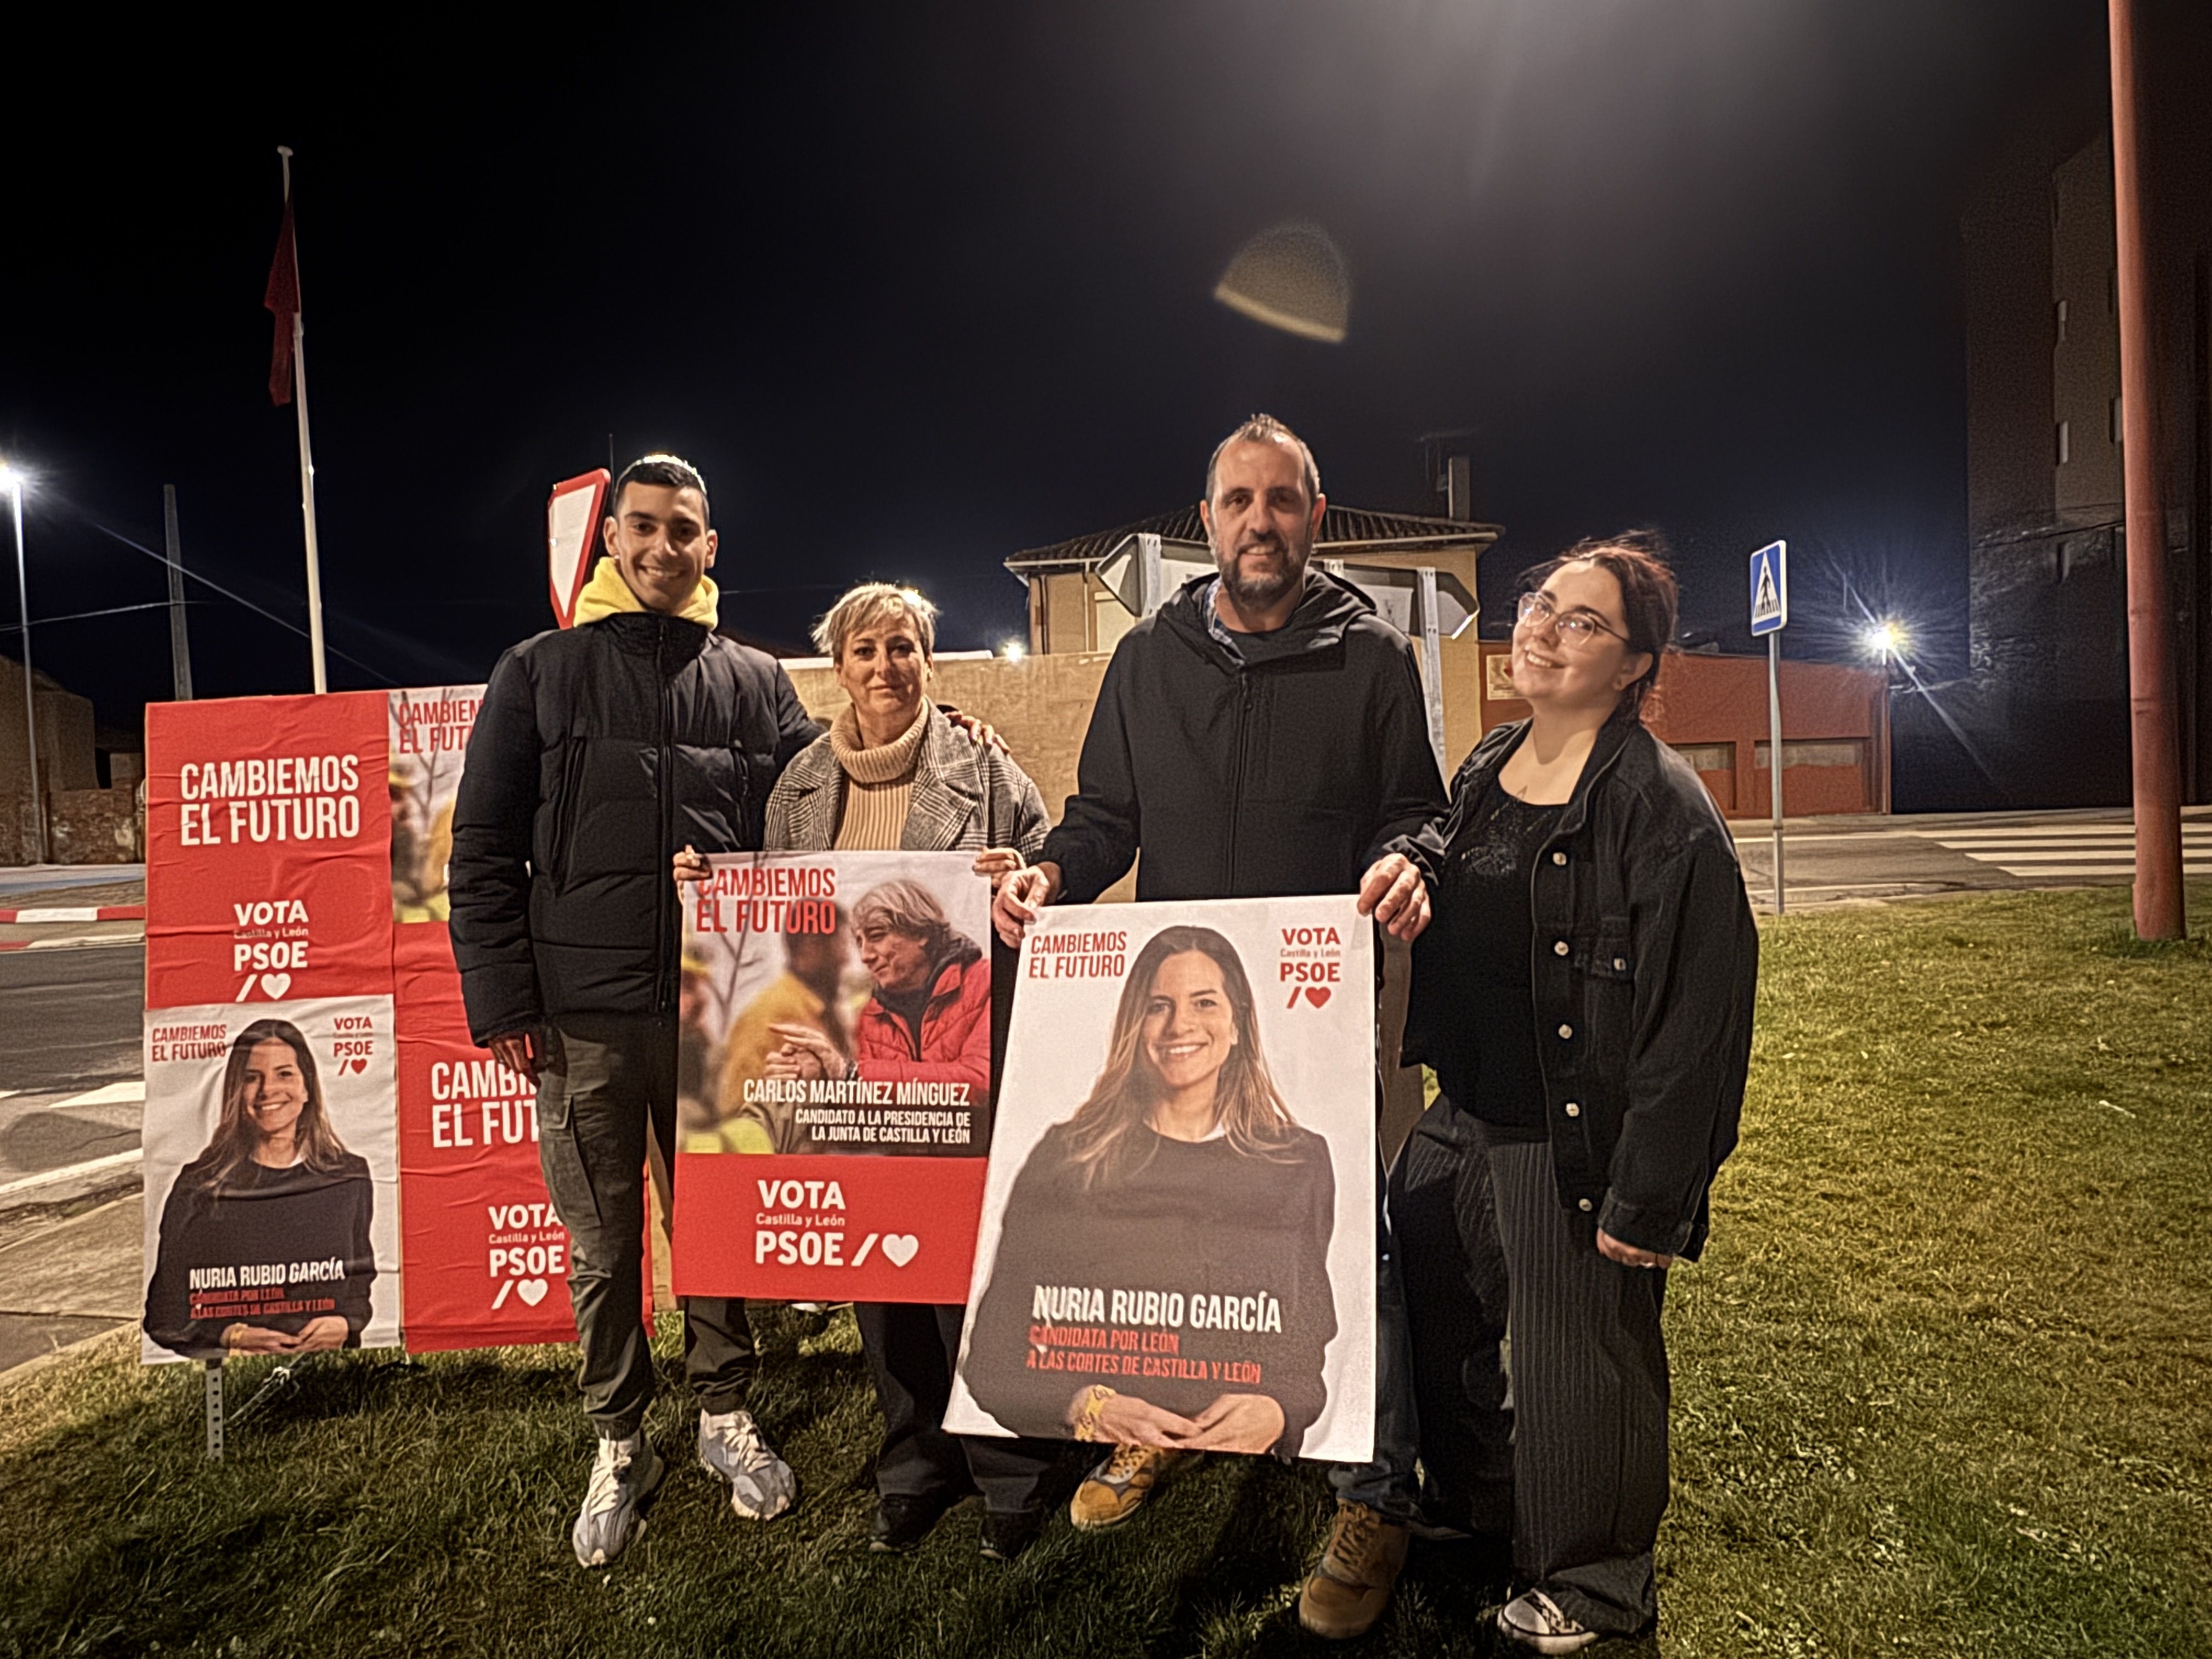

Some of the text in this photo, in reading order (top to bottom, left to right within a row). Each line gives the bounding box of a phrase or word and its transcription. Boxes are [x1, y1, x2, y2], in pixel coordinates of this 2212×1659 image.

[399, 725, 473, 754] EL FUT
[180, 754, 359, 800] CAMBIEMOS
[180, 795, 360, 846] EL FUTURO
[698, 867, 836, 897] CAMBIEMOS
[234, 900, 309, 927] VOTA
[696, 899, 836, 934] EL FUTURO
[1031, 931, 1127, 955] CAMBIEMOS
[1282, 927, 1341, 946] VOTA
[234, 941, 309, 972] PSOE
[1029, 953, 1125, 979] EL FUTURO
[1280, 962, 1341, 983] PSOE
[152, 1024, 227, 1043] CAMBIEMOS
[334, 1017, 373, 1030] VOTA
[152, 1041, 226, 1062] EL FUTURO
[333, 1040, 374, 1058] PSOE
[432, 1060, 538, 1101] CAMBI
[743, 1077, 970, 1107] CARLOS MARTÍNEZ MÍNGUEZ
[432, 1103, 473, 1148] EL
[795, 1108, 971, 1128] CANDIDATO A LA PRESIDENCIA DE
[811, 1125, 970, 1144] LA JUNTA DE CASTILLA Y LEÓN
[757, 1180, 846, 1210] VOTA
[488, 1201, 563, 1231] VOTA
[755, 1212, 845, 1228] Castilla y León
[488, 1228, 565, 1244] Castilla y León
[755, 1230, 844, 1266] PSOE
[190, 1256, 346, 1290] NURIA RUBIO GARCÍA
[489, 1244, 566, 1278] PSOE
[1032, 1284, 1282, 1334] NURIA RUBIO GARCÍA
[1028, 1324, 1107, 1349] CANDIDATA
[1110, 1329, 1139, 1351] POR
[1026, 1349, 1036, 1369] A
[1039, 1350, 1065, 1370] LAS
[1066, 1351, 1120, 1374] CORTES
[1122, 1355, 1141, 1375] DE
[1142, 1356, 1207, 1381] CASTILLA
[1210, 1361, 1222, 1380] Y
